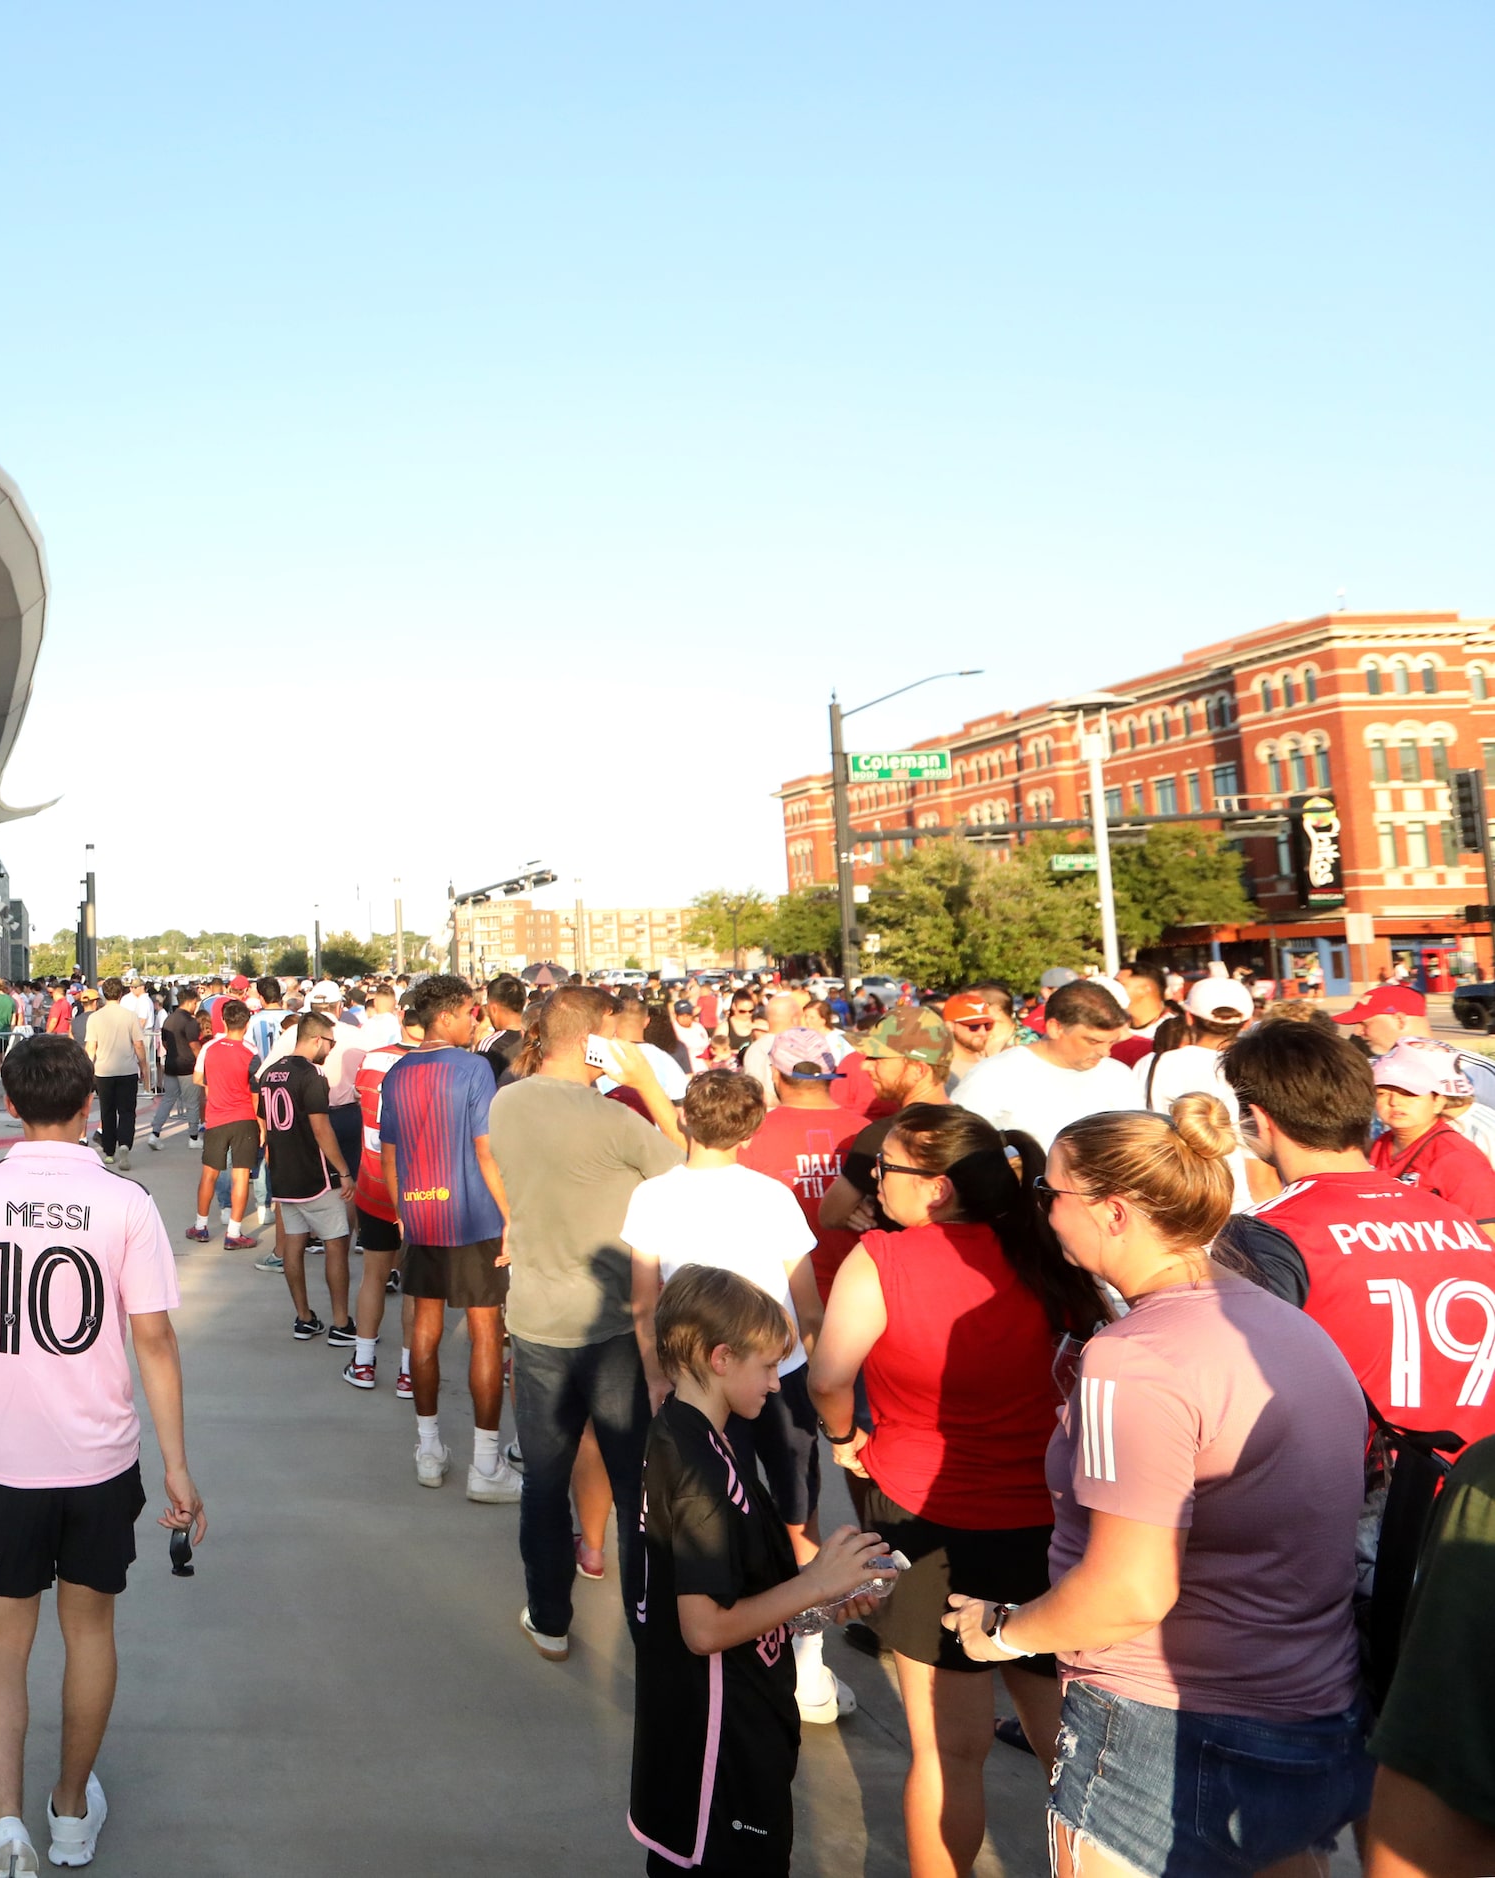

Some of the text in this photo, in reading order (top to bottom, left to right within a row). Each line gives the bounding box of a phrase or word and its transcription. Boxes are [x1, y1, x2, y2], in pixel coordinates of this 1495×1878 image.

[858, 754, 941, 771] Coleman
[265, 1071, 290, 1083] MESSI
[261, 1086, 294, 1131] 10
[403, 1186, 437, 1202] unicef
[6, 1200, 91, 1232] MESSI
[1366, 1277, 1495, 1408] 19
